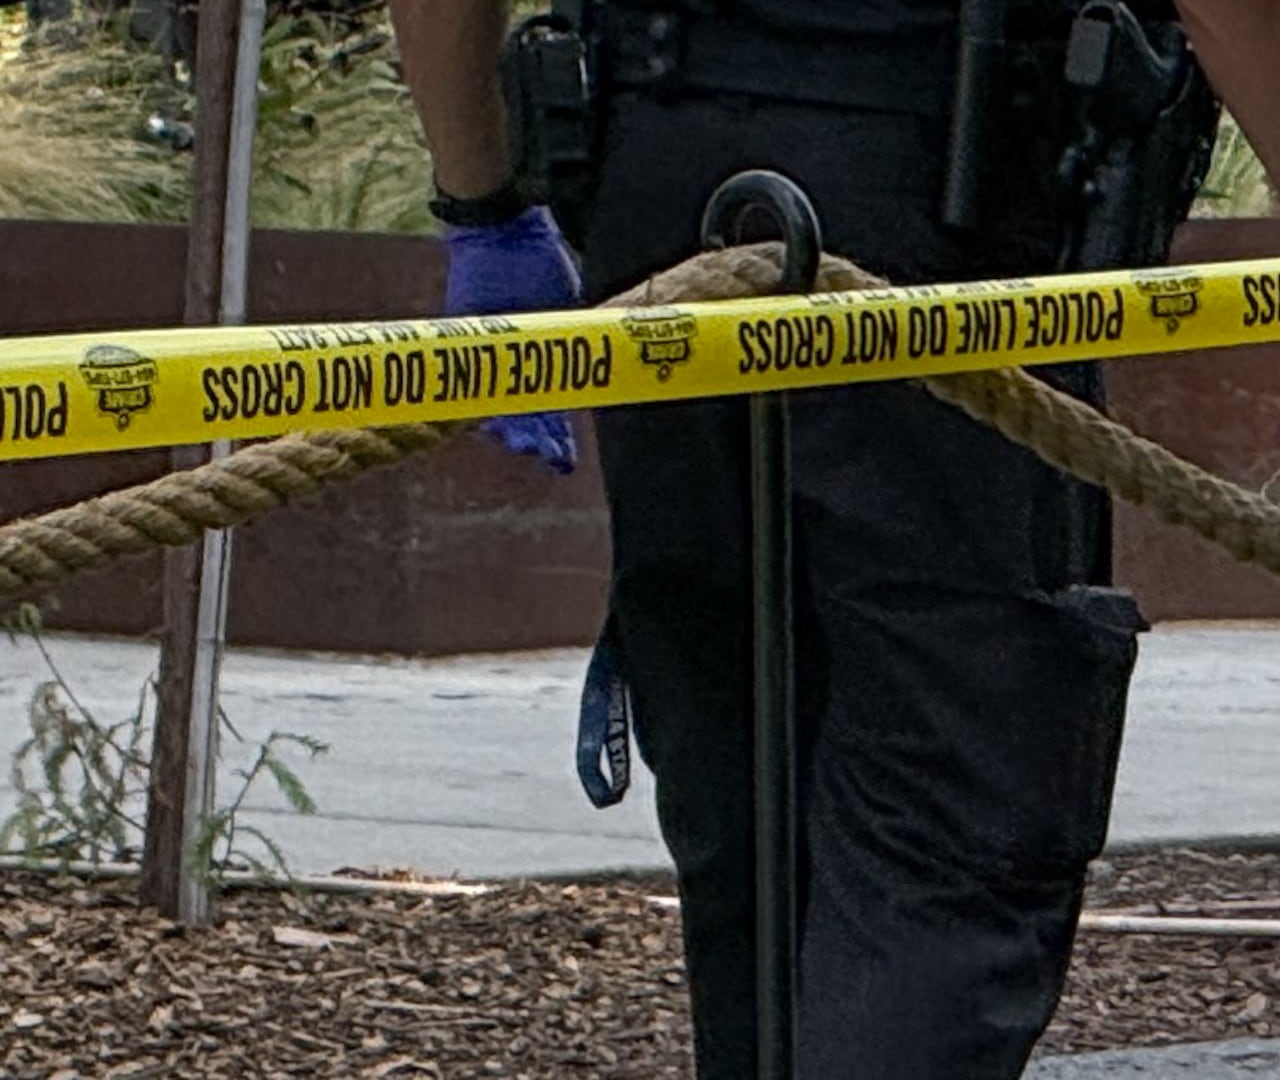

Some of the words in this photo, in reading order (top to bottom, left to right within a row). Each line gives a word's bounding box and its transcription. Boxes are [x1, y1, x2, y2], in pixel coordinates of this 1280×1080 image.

[738, 313, 835, 376] CROSS
[841, 307, 898, 366] NOT
[908, 303, 949, 360] DO
[954, 297, 1018, 356] LINE
[1023, 287, 1124, 349] POLICE
[202, 359, 306, 423] CROSS
[312, 353, 373, 413] NOT
[383, 349, 426, 408] DO
[433, 343, 498, 403] LINE
[505, 333, 613, 397] POLICE
